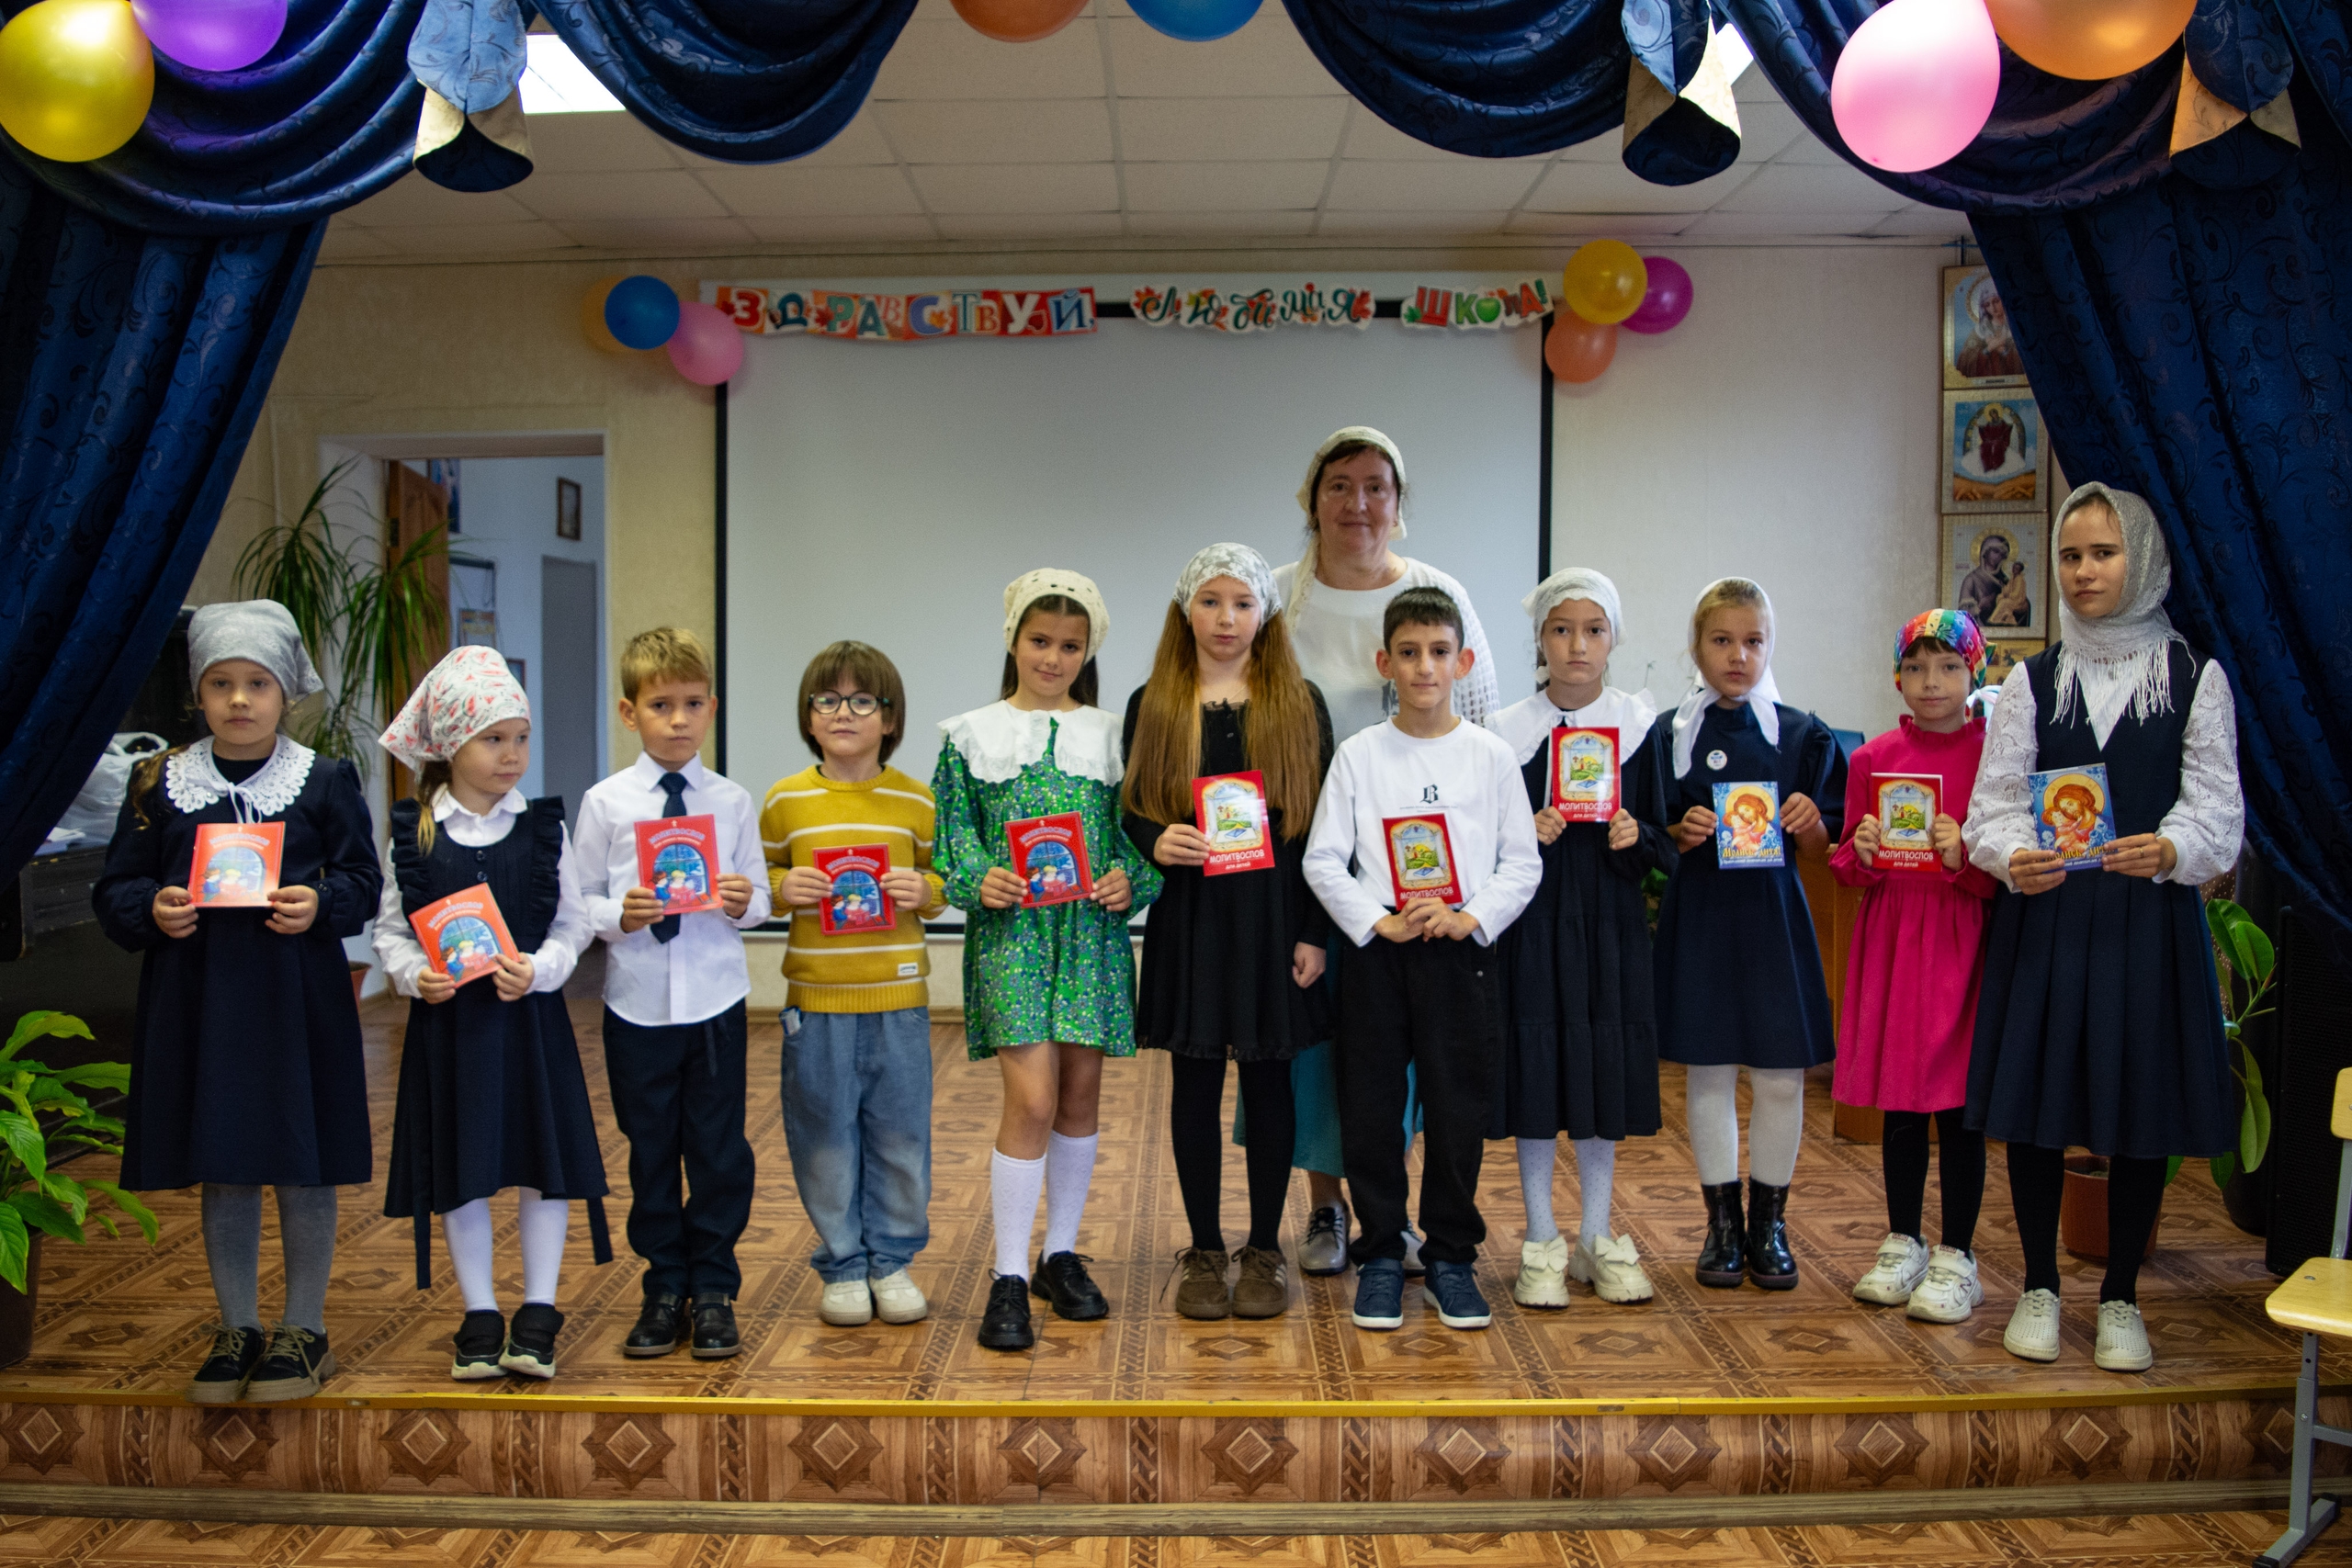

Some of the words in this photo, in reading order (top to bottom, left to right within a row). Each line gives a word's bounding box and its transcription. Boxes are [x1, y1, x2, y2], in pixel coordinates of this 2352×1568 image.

[734, 288, 1094, 337] ЗДРАВСТВУЙ,
[1559, 802, 1612, 810] МОЛИТВОСЛОВ
[1209, 849, 1264, 863] МОЛИТВОСЛОВ
[1879, 850, 1933, 861] МОЛИТВОСЛОВ
